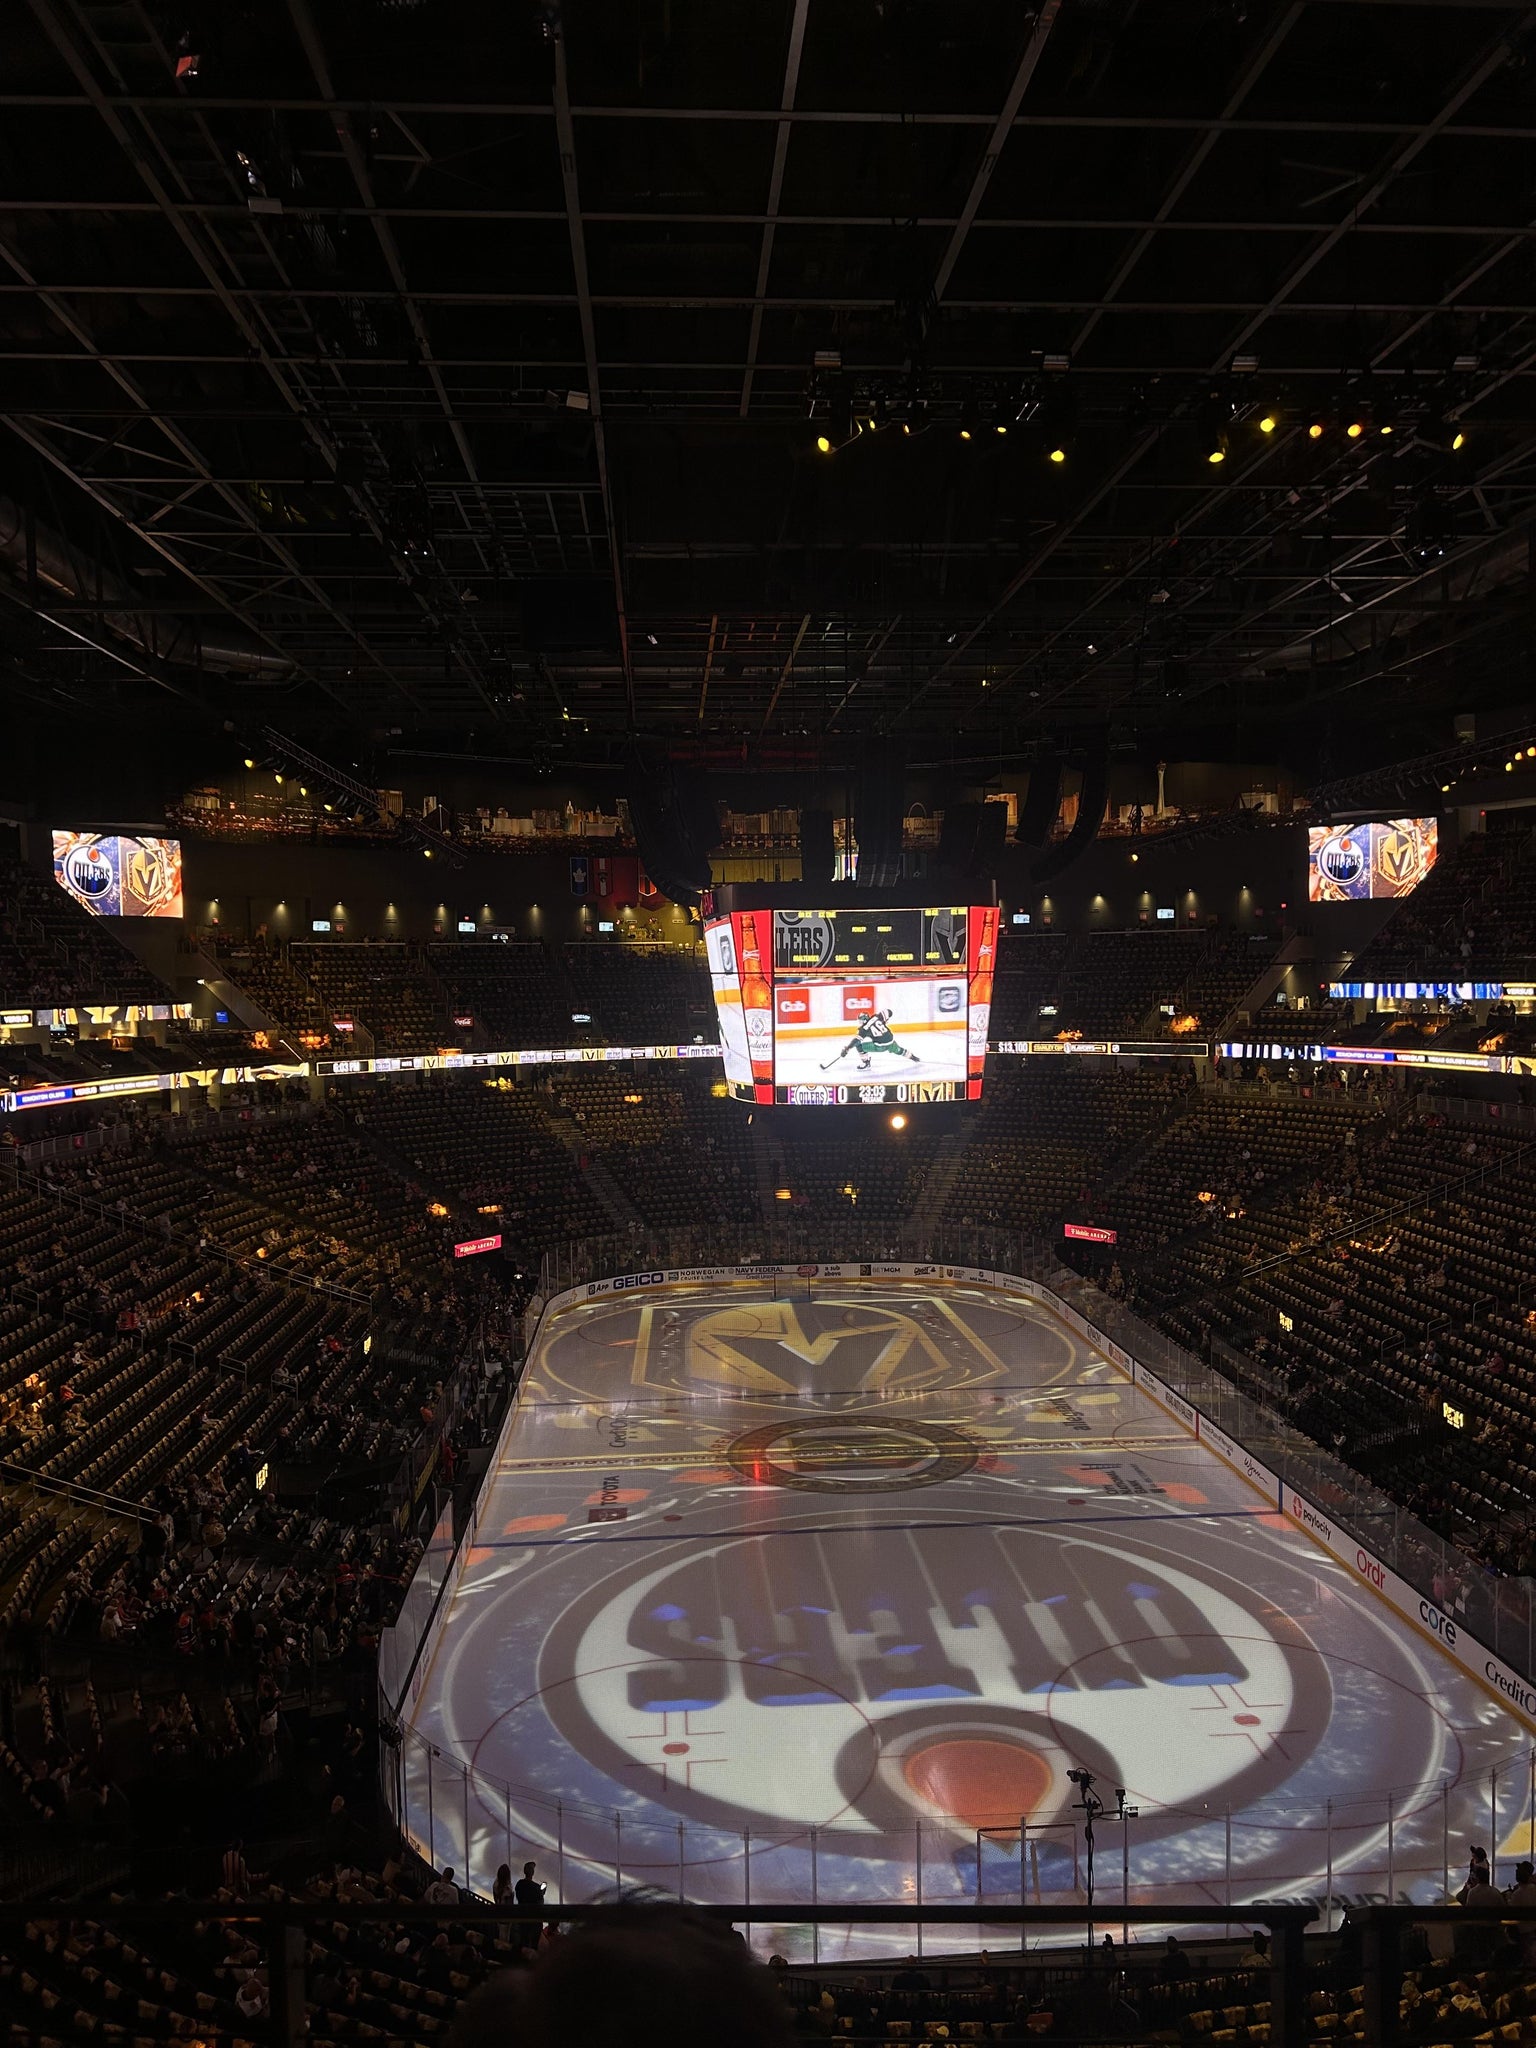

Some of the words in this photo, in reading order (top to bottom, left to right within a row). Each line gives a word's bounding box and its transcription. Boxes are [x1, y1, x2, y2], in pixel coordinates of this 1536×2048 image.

[845, 997, 872, 1009] Cub
[799, 1091, 824, 1104] OILERS
[838, 1085, 848, 1103] 0
[858, 1085, 886, 1097] 23:03
[896, 1083, 906, 1102] 0
[755, 1265, 784, 1273] FEDERAL
[613, 1272, 664, 1290] GEICO
[600, 1475, 620, 1506] TOYOTA
[1303, 1509, 1332, 1541] paylocity
[1357, 1549, 1386, 1590] Ordr
[1419, 1600, 1456, 1645] core
